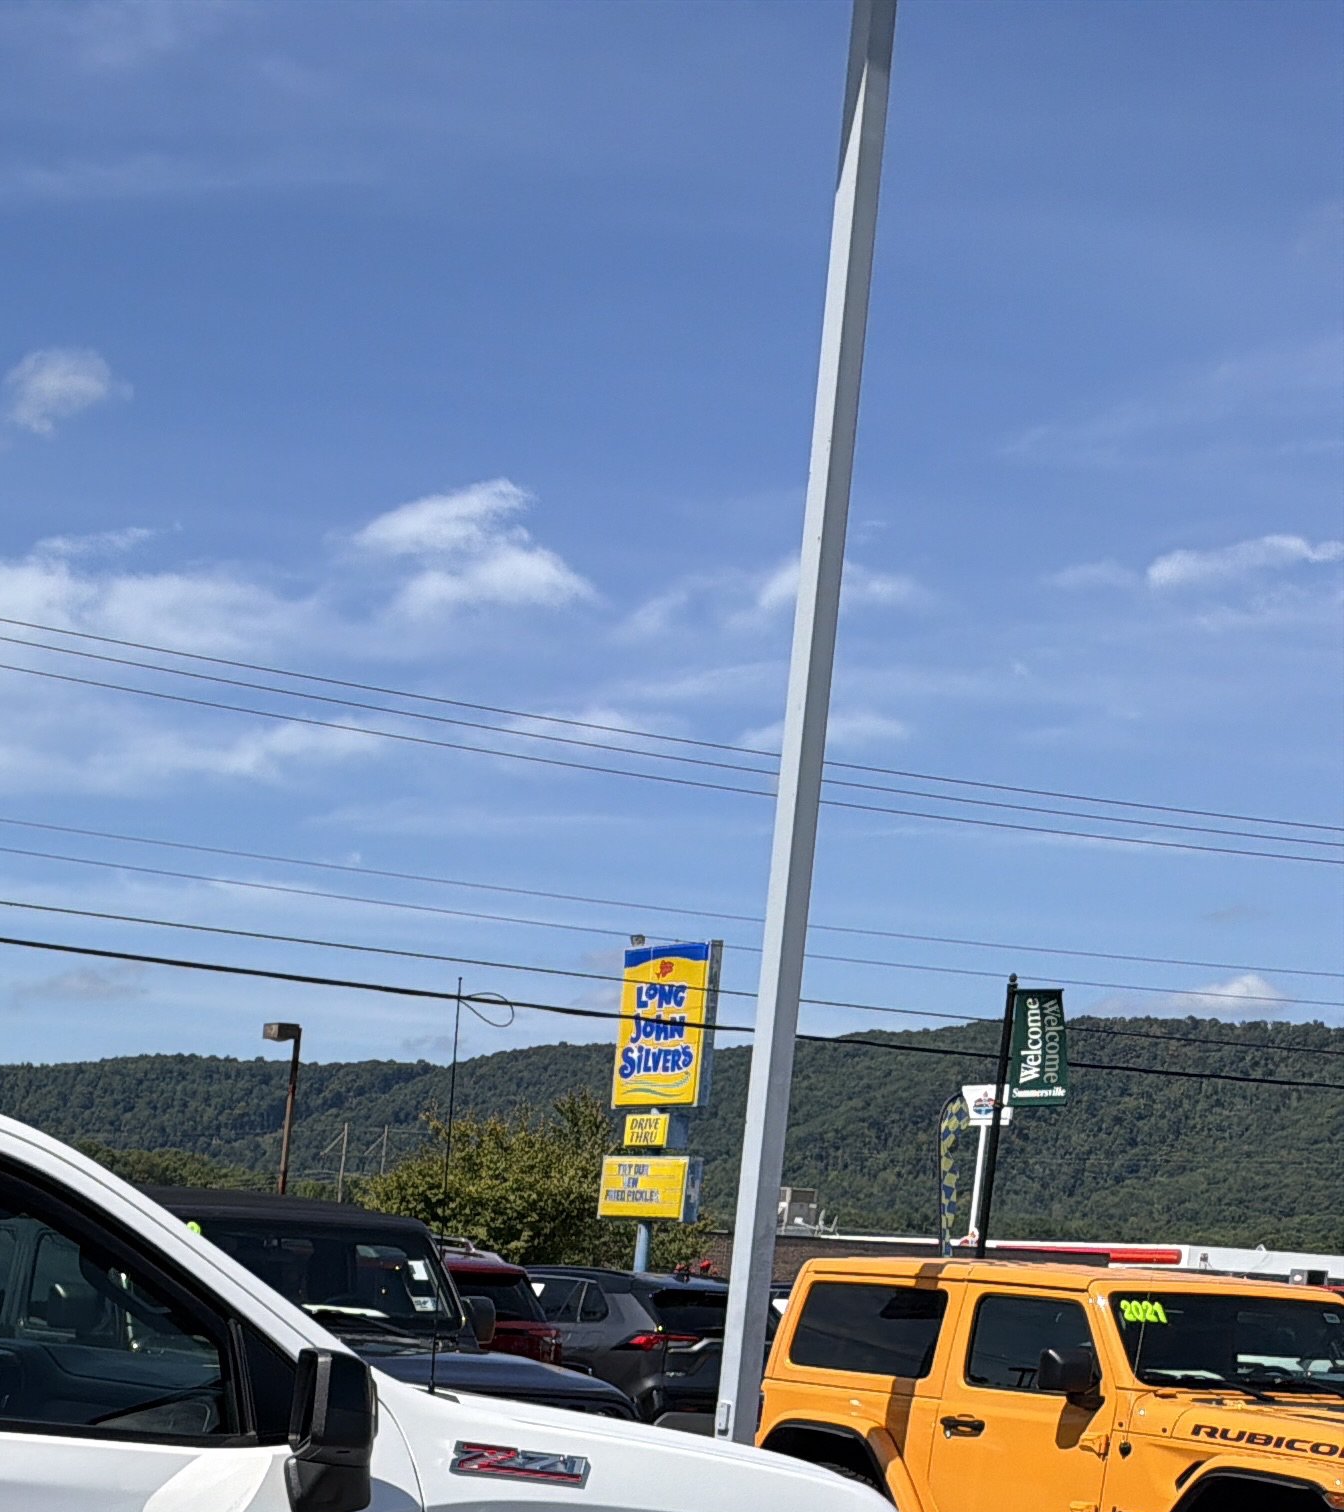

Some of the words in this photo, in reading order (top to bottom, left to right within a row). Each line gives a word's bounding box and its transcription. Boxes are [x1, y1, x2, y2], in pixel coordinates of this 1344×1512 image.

[636, 984, 688, 1009] LONG
[630, 1013, 686, 1044] JOHN
[1019, 997, 1043, 1085] Welcome
[1042, 998, 1065, 1084] Welcome
[619, 1045, 694, 1079] SILVER'S
[1012, 1085, 1067, 1099] Summersville
[629, 1117, 660, 1131] DRIVE
[629, 1131, 658, 1144] THRU
[1120, 1299, 1168, 1324] 2021
[1191, 1423, 1344, 1459] RUBICO
[453, 1441, 589, 1486] Z71
